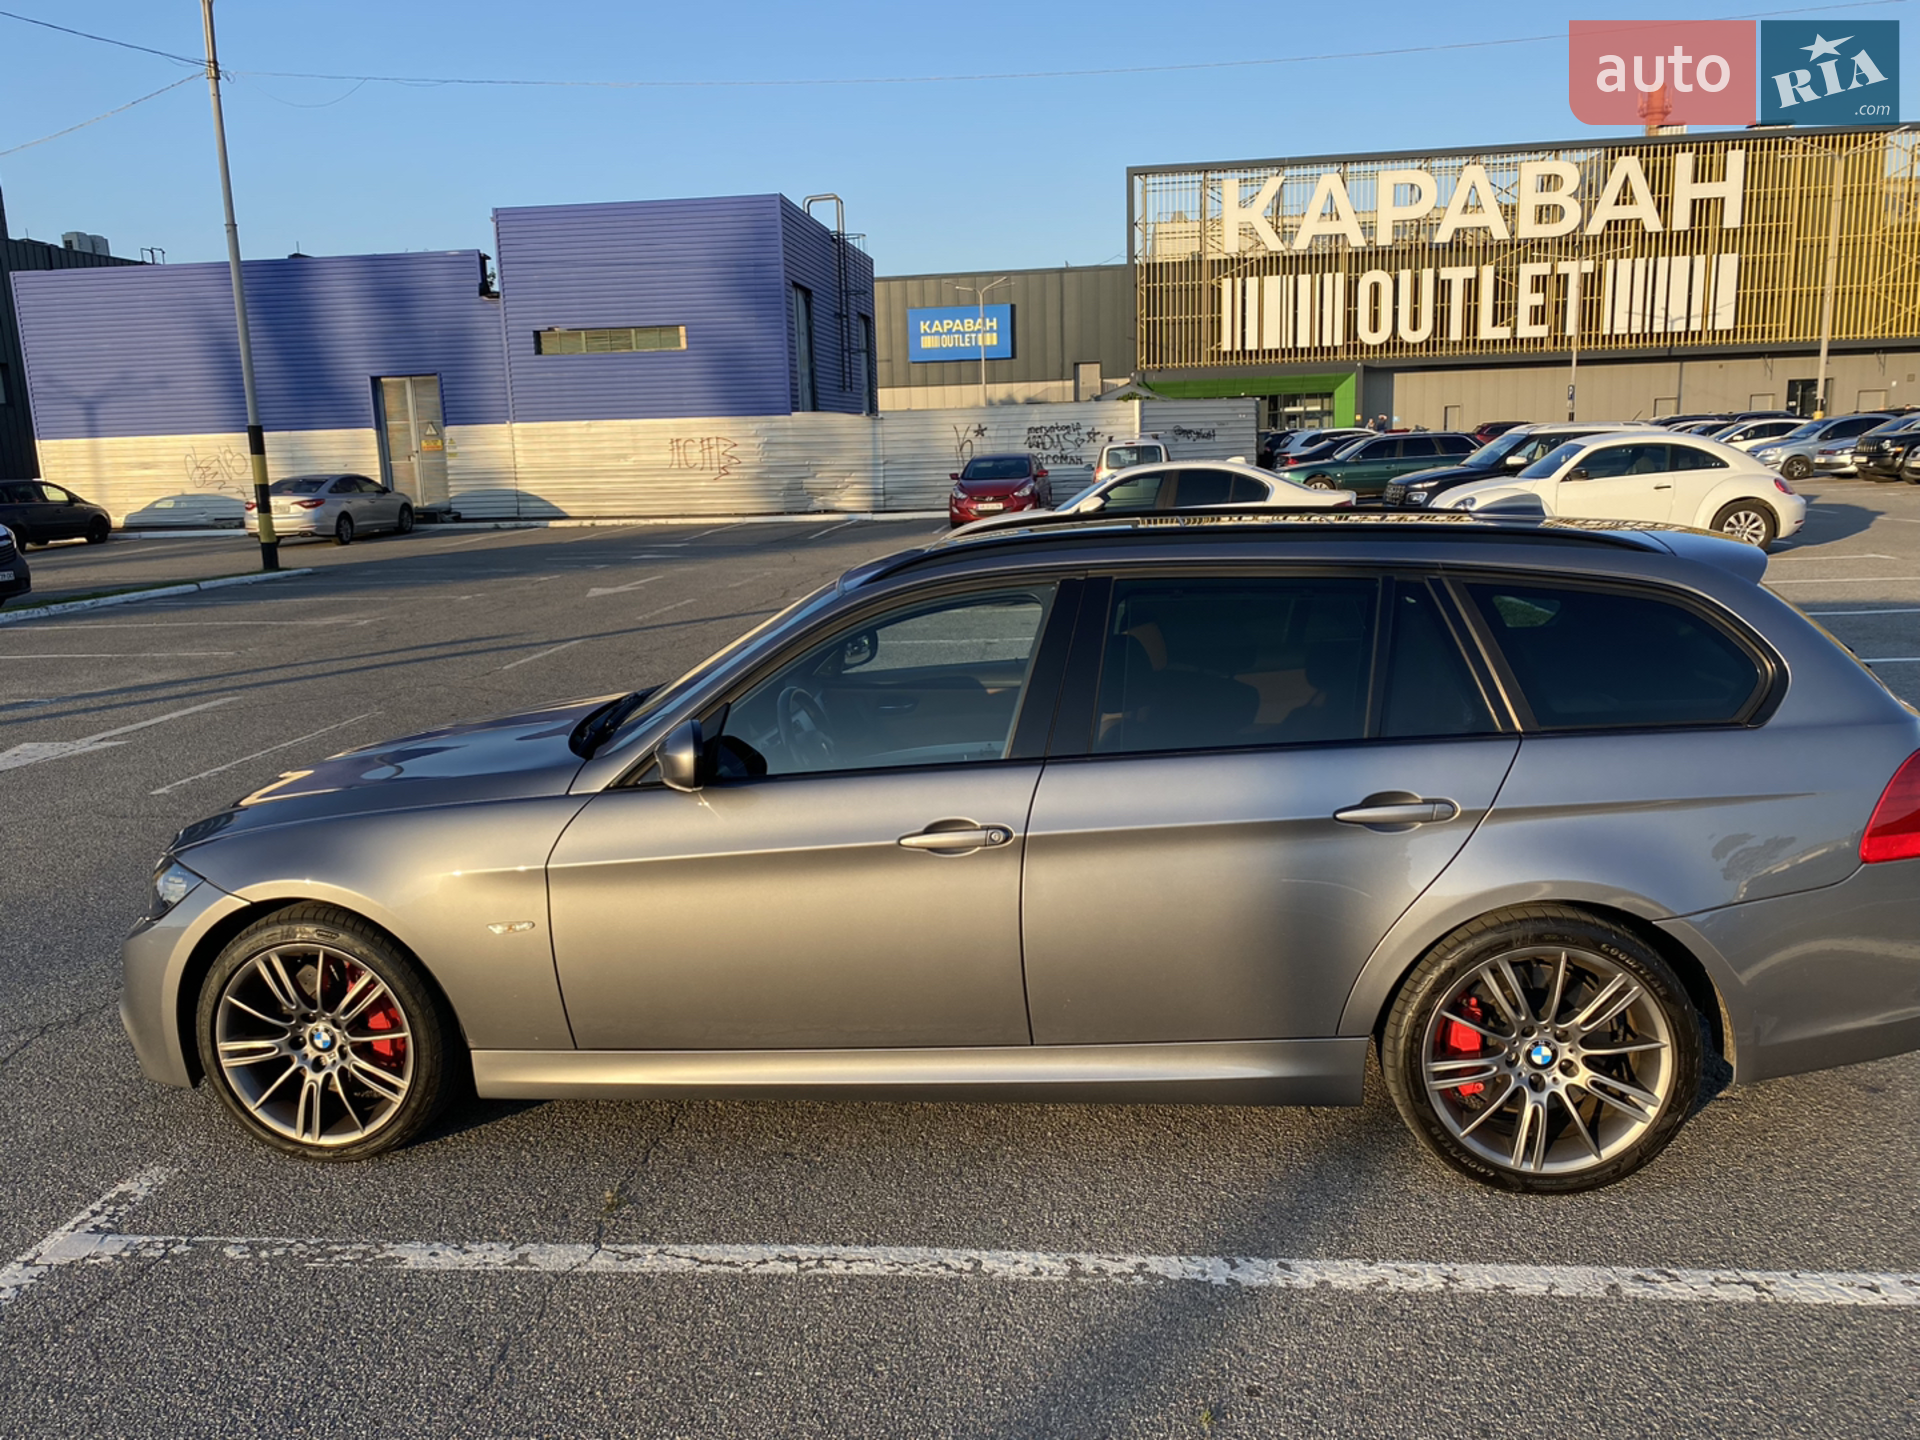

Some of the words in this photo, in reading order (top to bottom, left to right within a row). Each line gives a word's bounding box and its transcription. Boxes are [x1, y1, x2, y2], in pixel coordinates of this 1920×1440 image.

[1222, 149, 1746, 254] КАРАВАН
[920, 317, 997, 334] КАРАВАН
[1356, 259, 1595, 346] OUTLET
[940, 333, 977, 348] OUTLET
